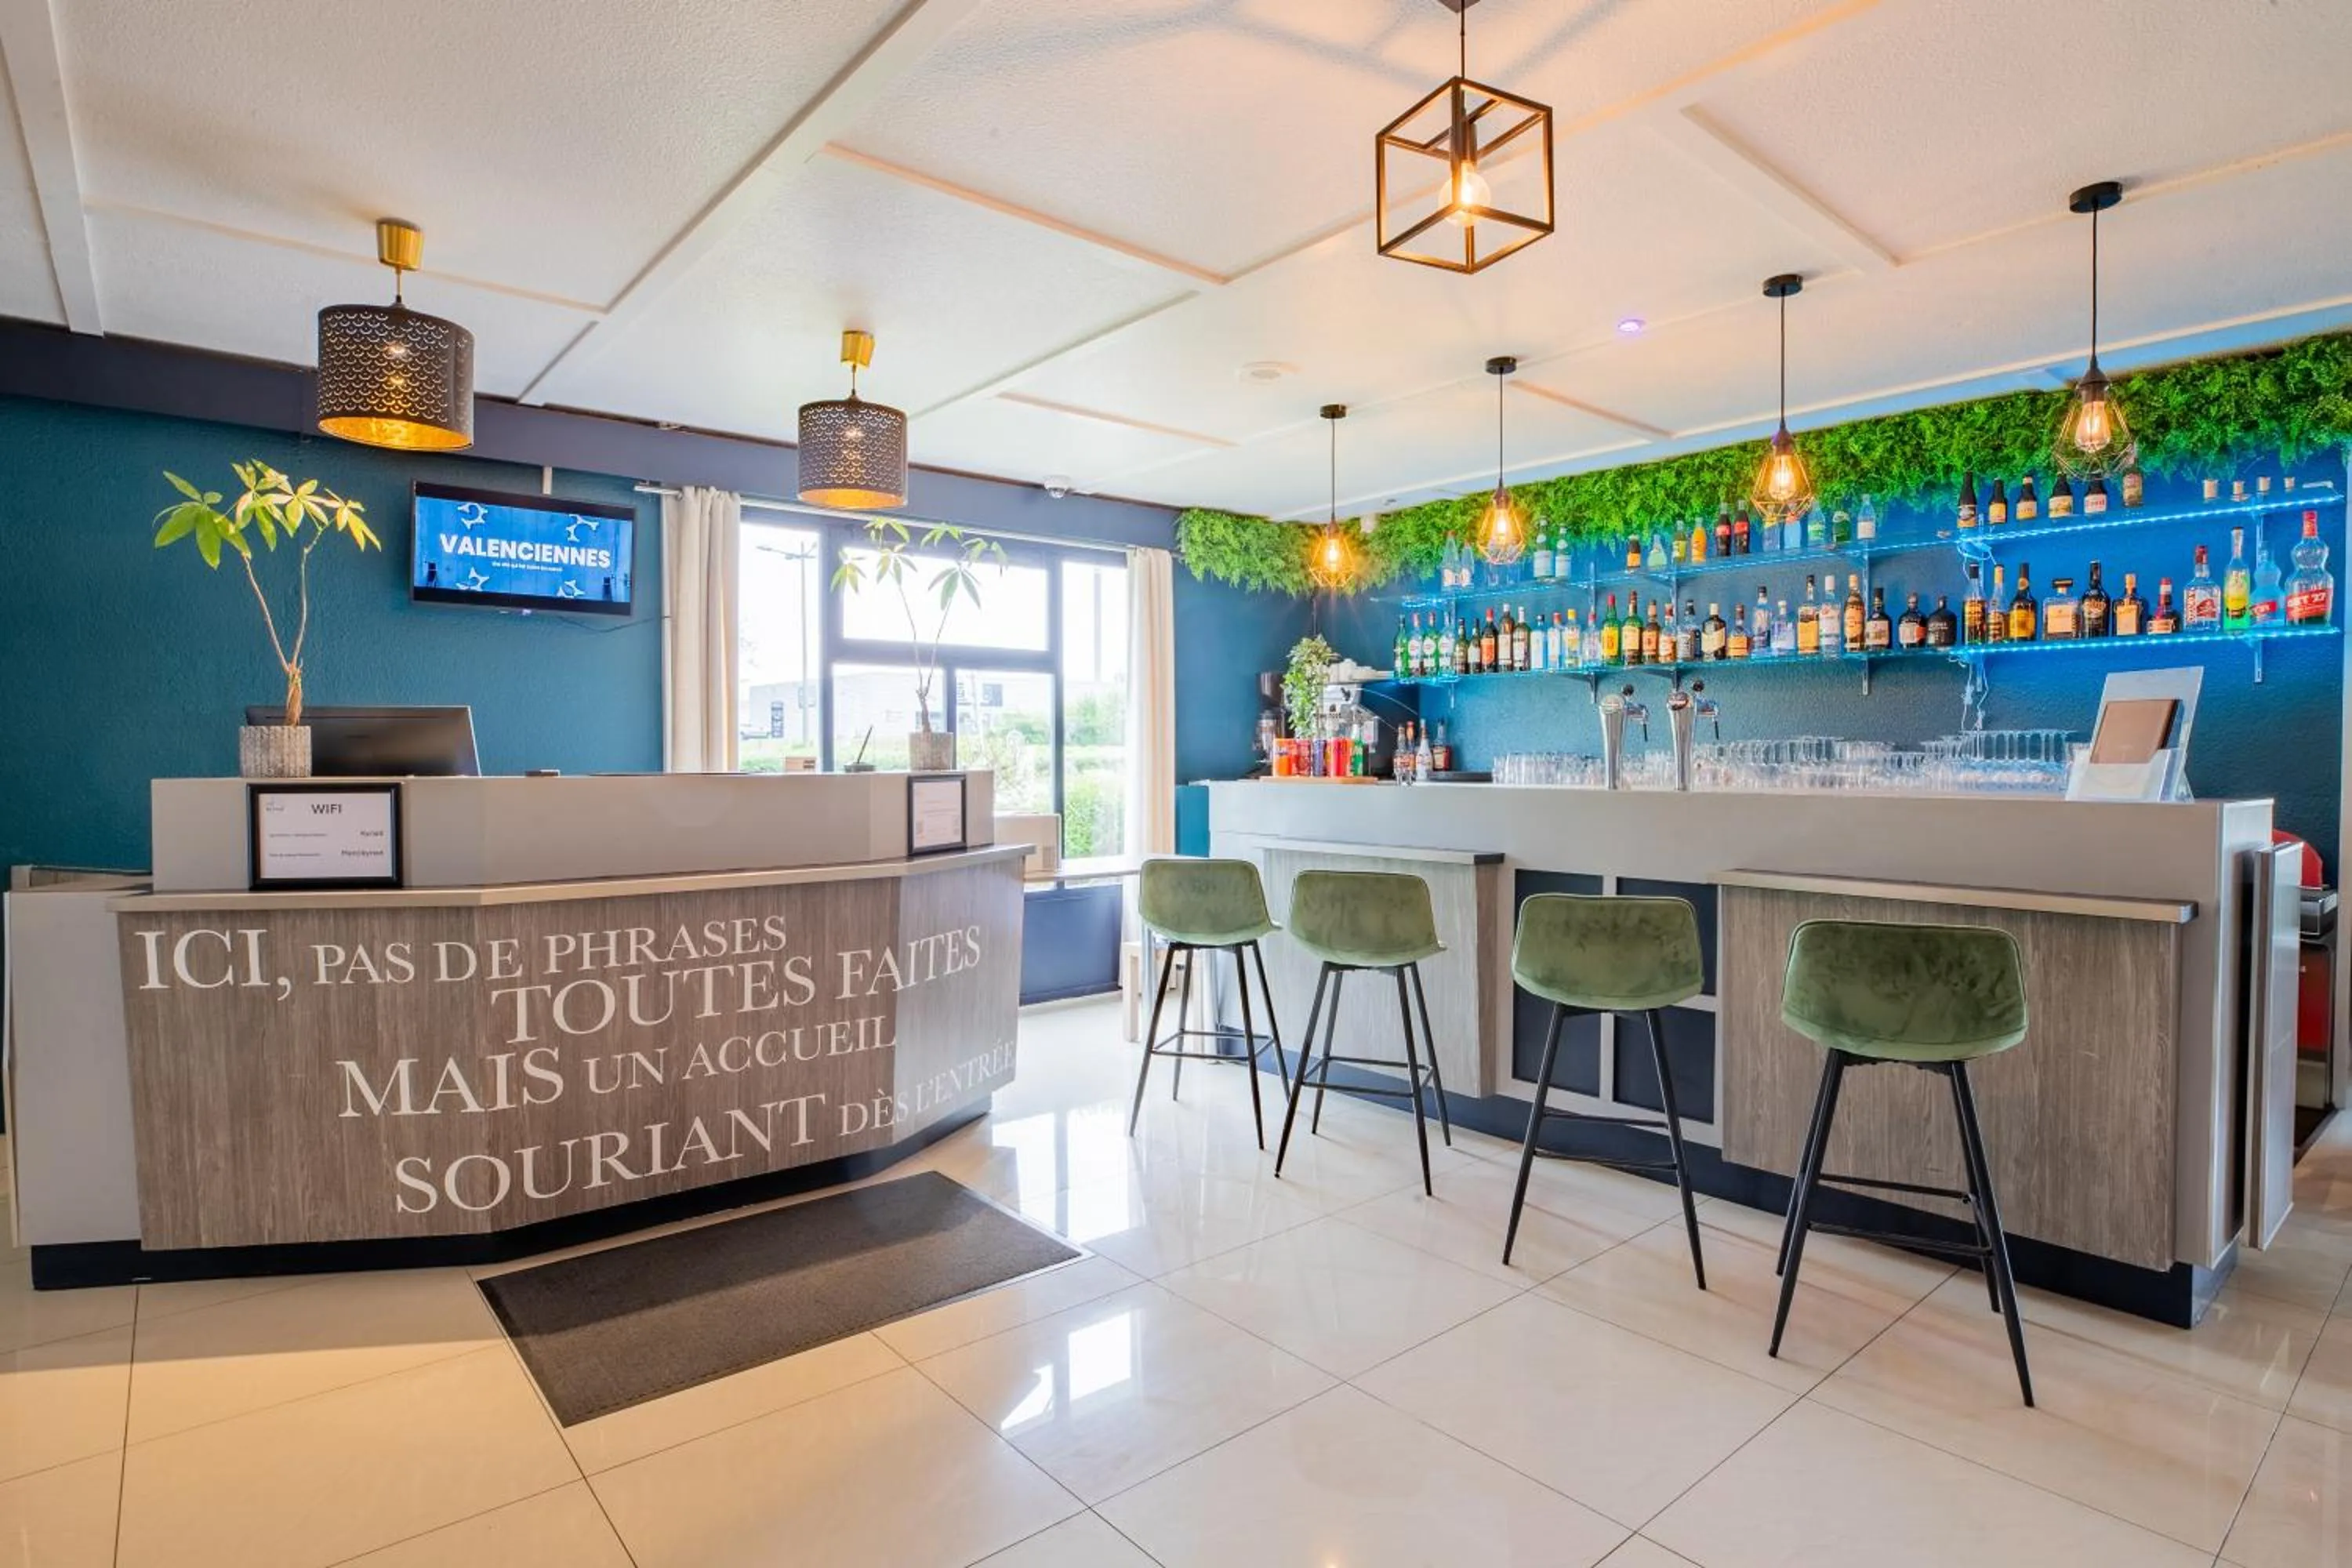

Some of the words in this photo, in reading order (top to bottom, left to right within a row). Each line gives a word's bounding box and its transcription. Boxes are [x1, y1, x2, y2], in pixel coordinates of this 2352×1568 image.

[440, 533, 611, 568] VALENCIENNES
[311, 804, 342, 814] WIFI
[134, 929, 292, 1001] ICI,
[310, 942, 416, 985] PAS
[433, 939, 524, 982] DE
[543, 915, 787, 975] PHRASES
[490, 955, 816, 1044] TOUTES
[836, 925, 982, 1000] FAITES
[335, 1047, 564, 1118] MAIS
[583, 1047, 669, 1094] UN
[682, 1014, 897, 1080] ACCUEIL
[395, 1093, 826, 1214] SOURIANT
[838, 1089, 909, 1137] DÈS
